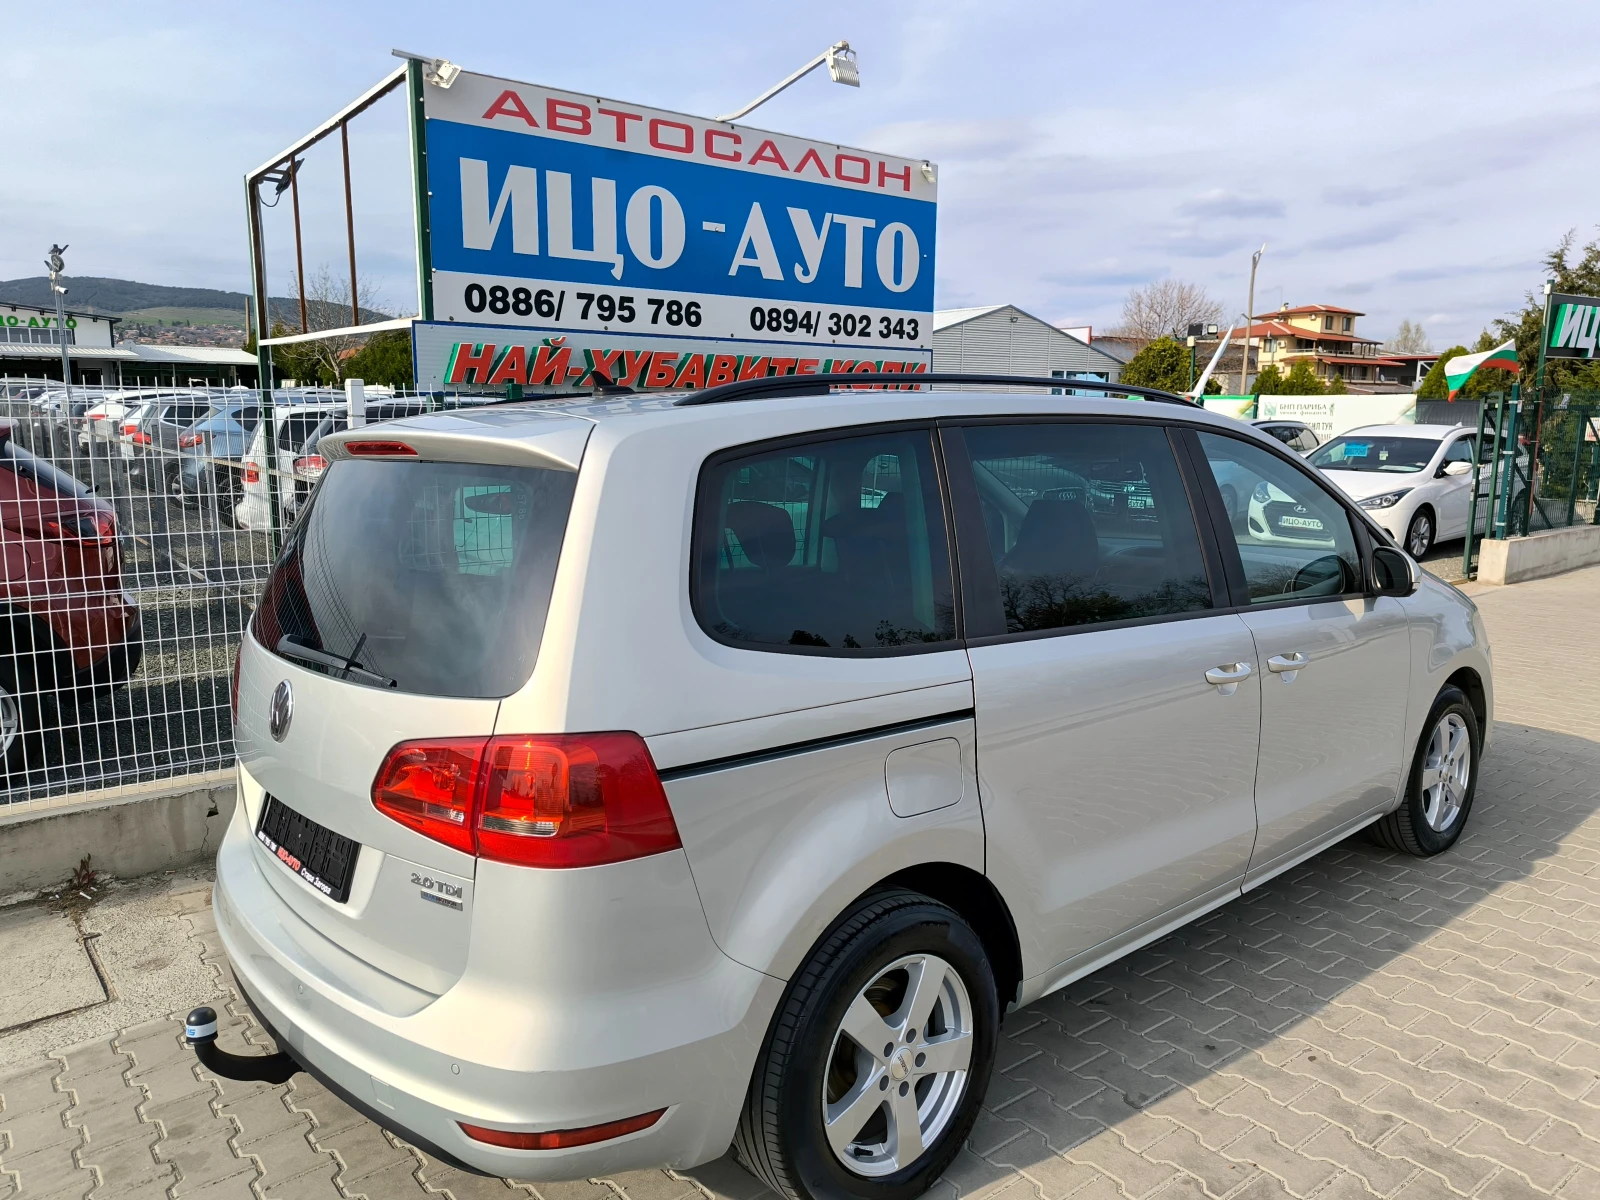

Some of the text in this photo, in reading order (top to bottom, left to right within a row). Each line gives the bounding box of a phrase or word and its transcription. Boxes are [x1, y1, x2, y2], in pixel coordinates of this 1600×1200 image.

[482, 90, 911, 192] АВТОСАЛОН
[464, 283, 702, 327] 0886/ 795 786
[750, 306, 919, 341] 0894/ 302 343
[410, 872, 462, 899] 2.0 TDI
